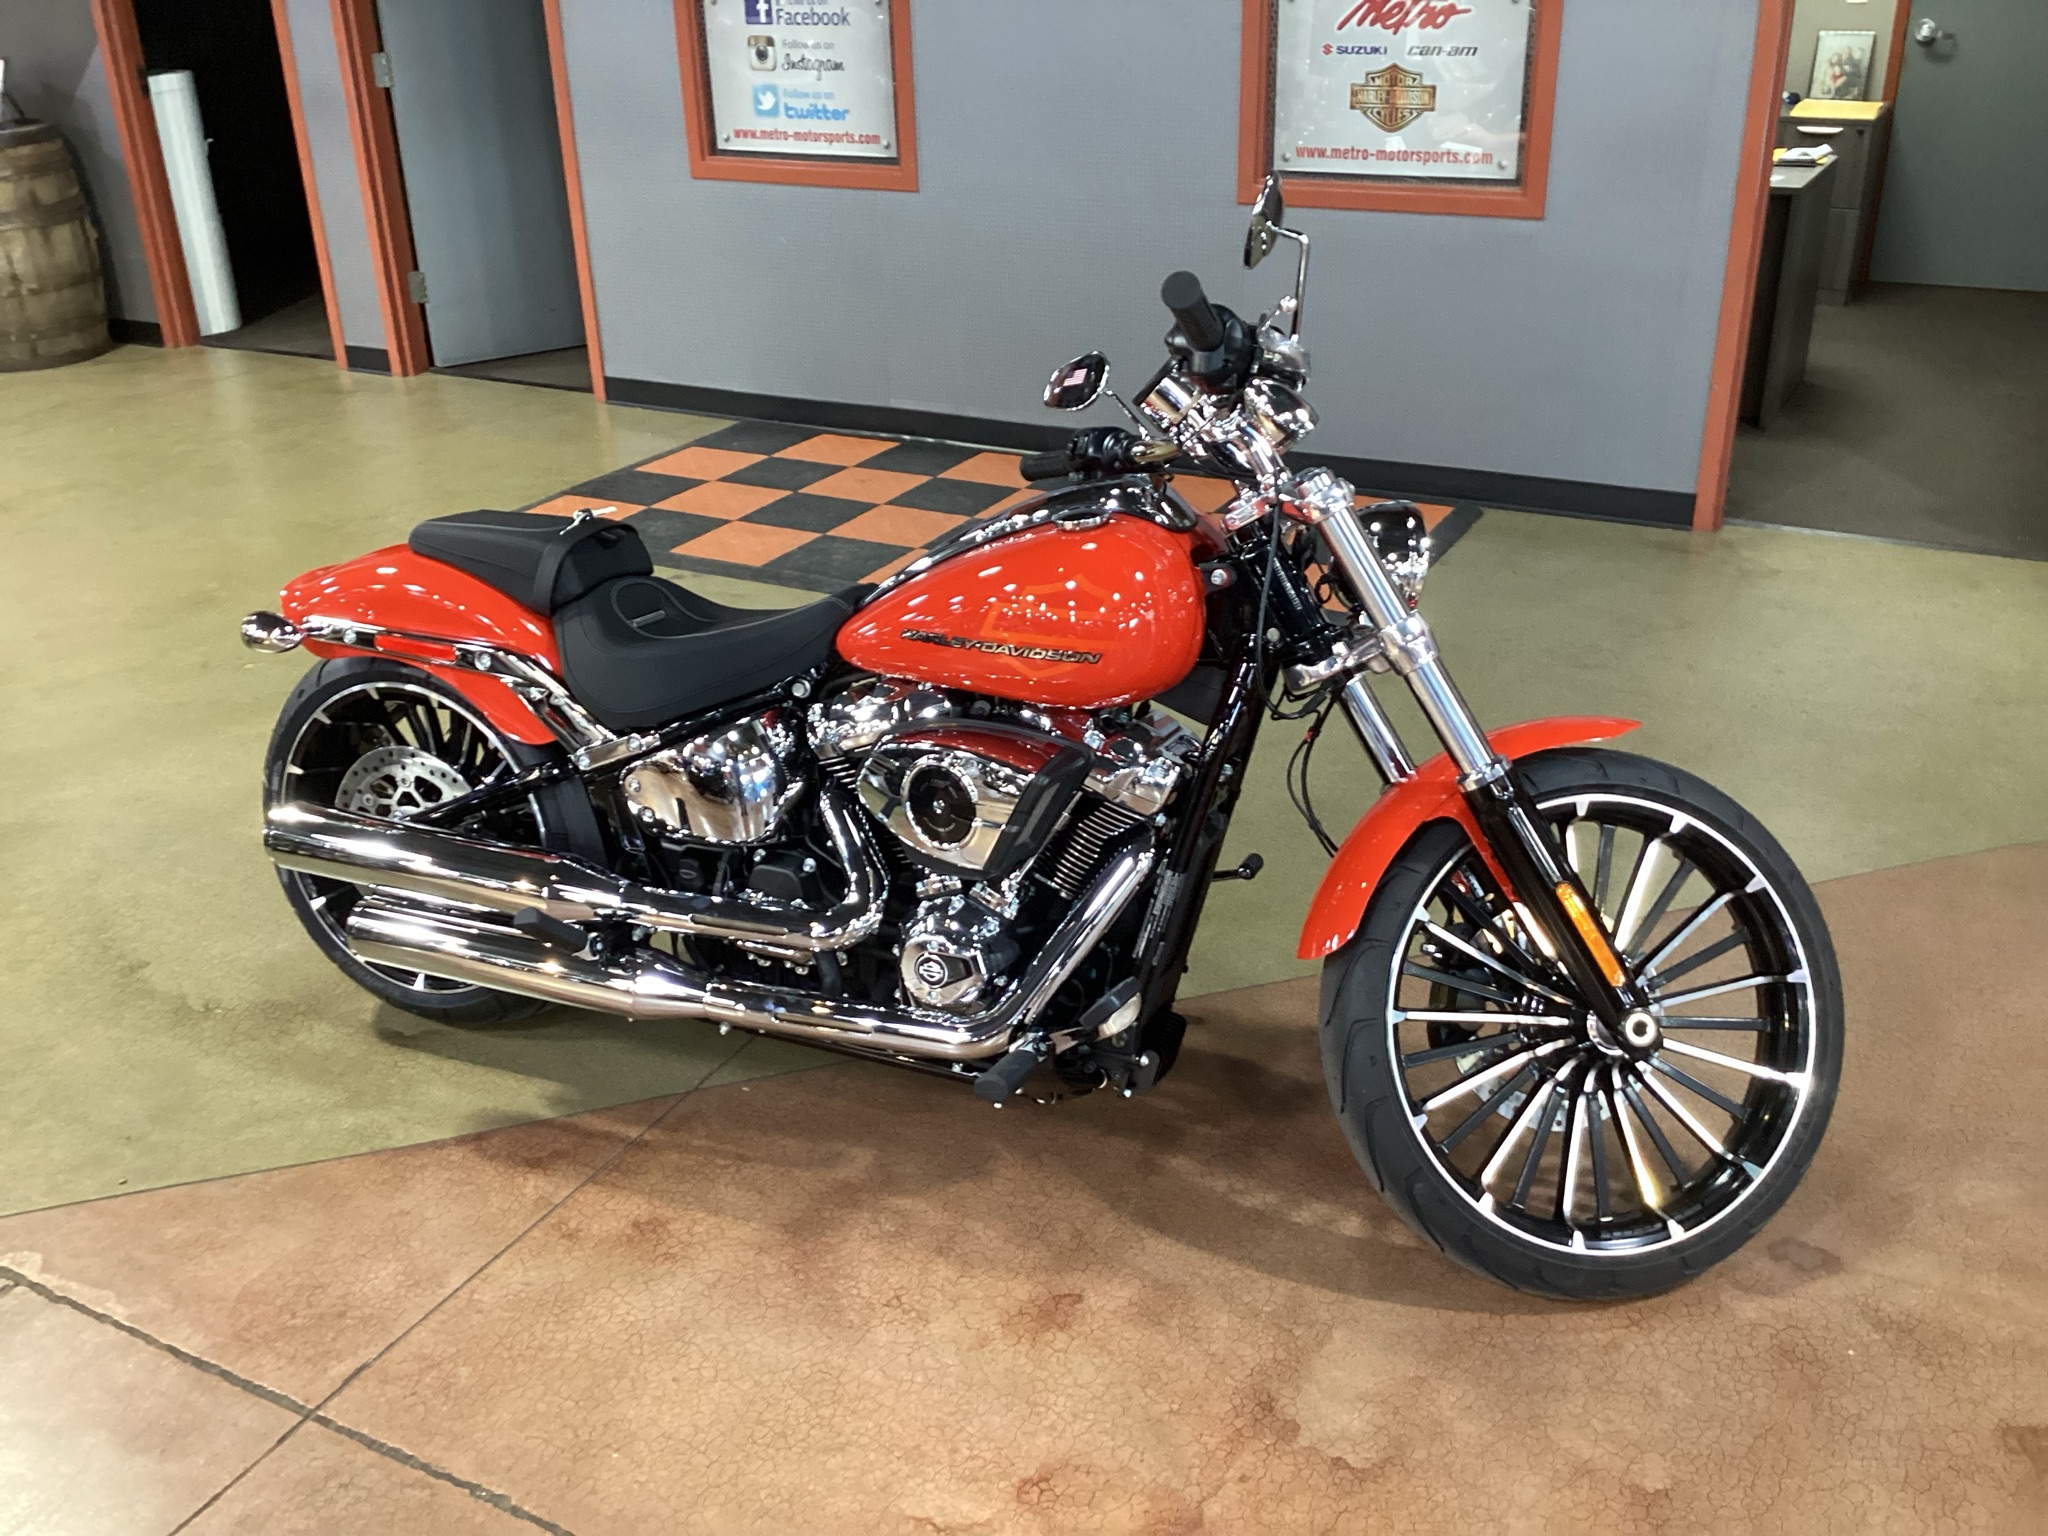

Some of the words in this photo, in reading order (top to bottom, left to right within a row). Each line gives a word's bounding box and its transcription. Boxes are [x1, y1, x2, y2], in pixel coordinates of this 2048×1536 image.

[776, 6, 851, 26] Facebook
[1337, 0, 1472, 35] Metro
[782, 39, 809, 49] Follow
[1336, 45, 1388, 55] SUZUKI
[1407, 45, 1478, 56] can-am
[782, 53, 845, 81] Instagram
[783, 88, 810, 99] Follow
[783, 102, 850, 120] twitter
[733, 128, 881, 145] www.metro-motorsports.com
[1295, 146, 1493, 165] www.metro-motorsports.com
